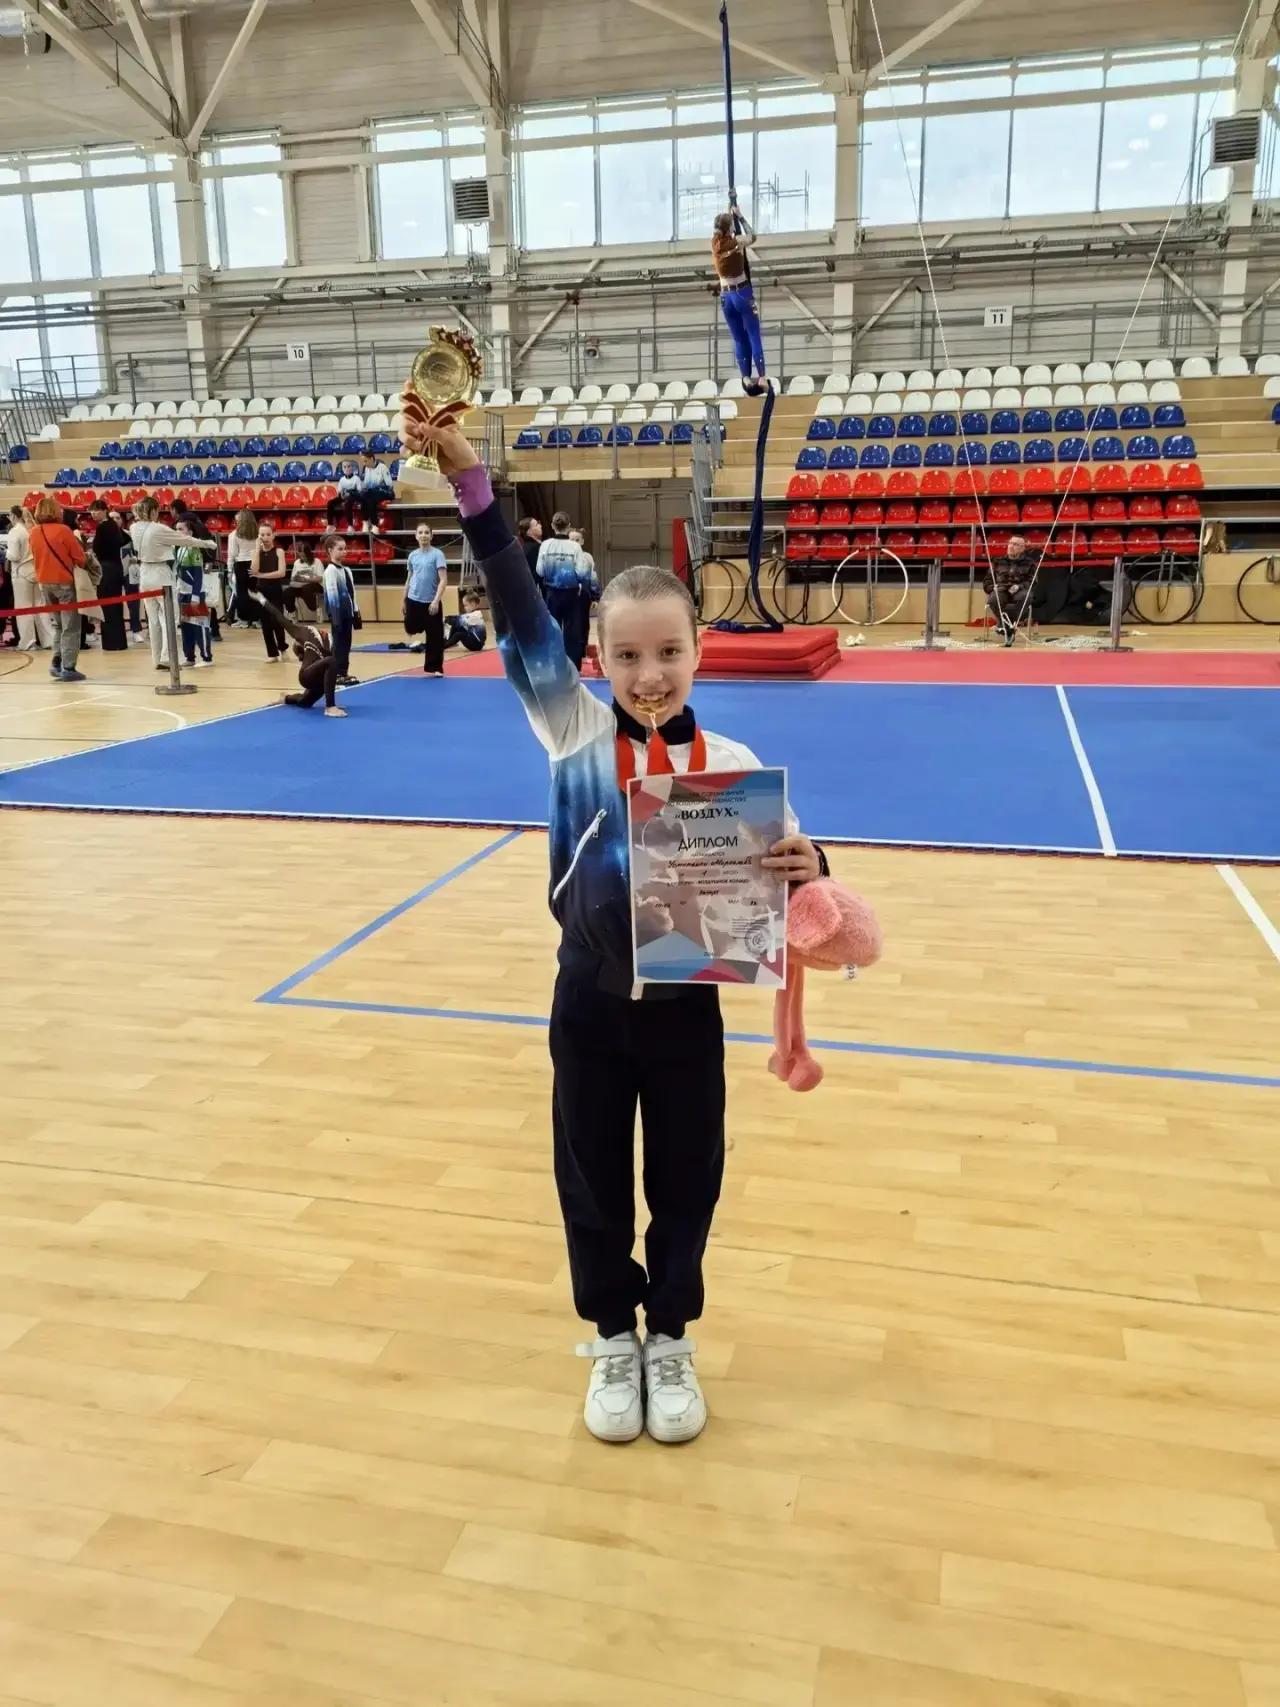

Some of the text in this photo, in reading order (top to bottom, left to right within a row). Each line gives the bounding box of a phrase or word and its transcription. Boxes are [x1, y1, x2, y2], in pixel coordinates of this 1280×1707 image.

[992, 313, 1004, 324] 11
[293, 349, 304, 359] 10
[674, 807, 740, 820] «ВОЗДУХ»
[677, 835, 738, 852] ДИПЛОМ
